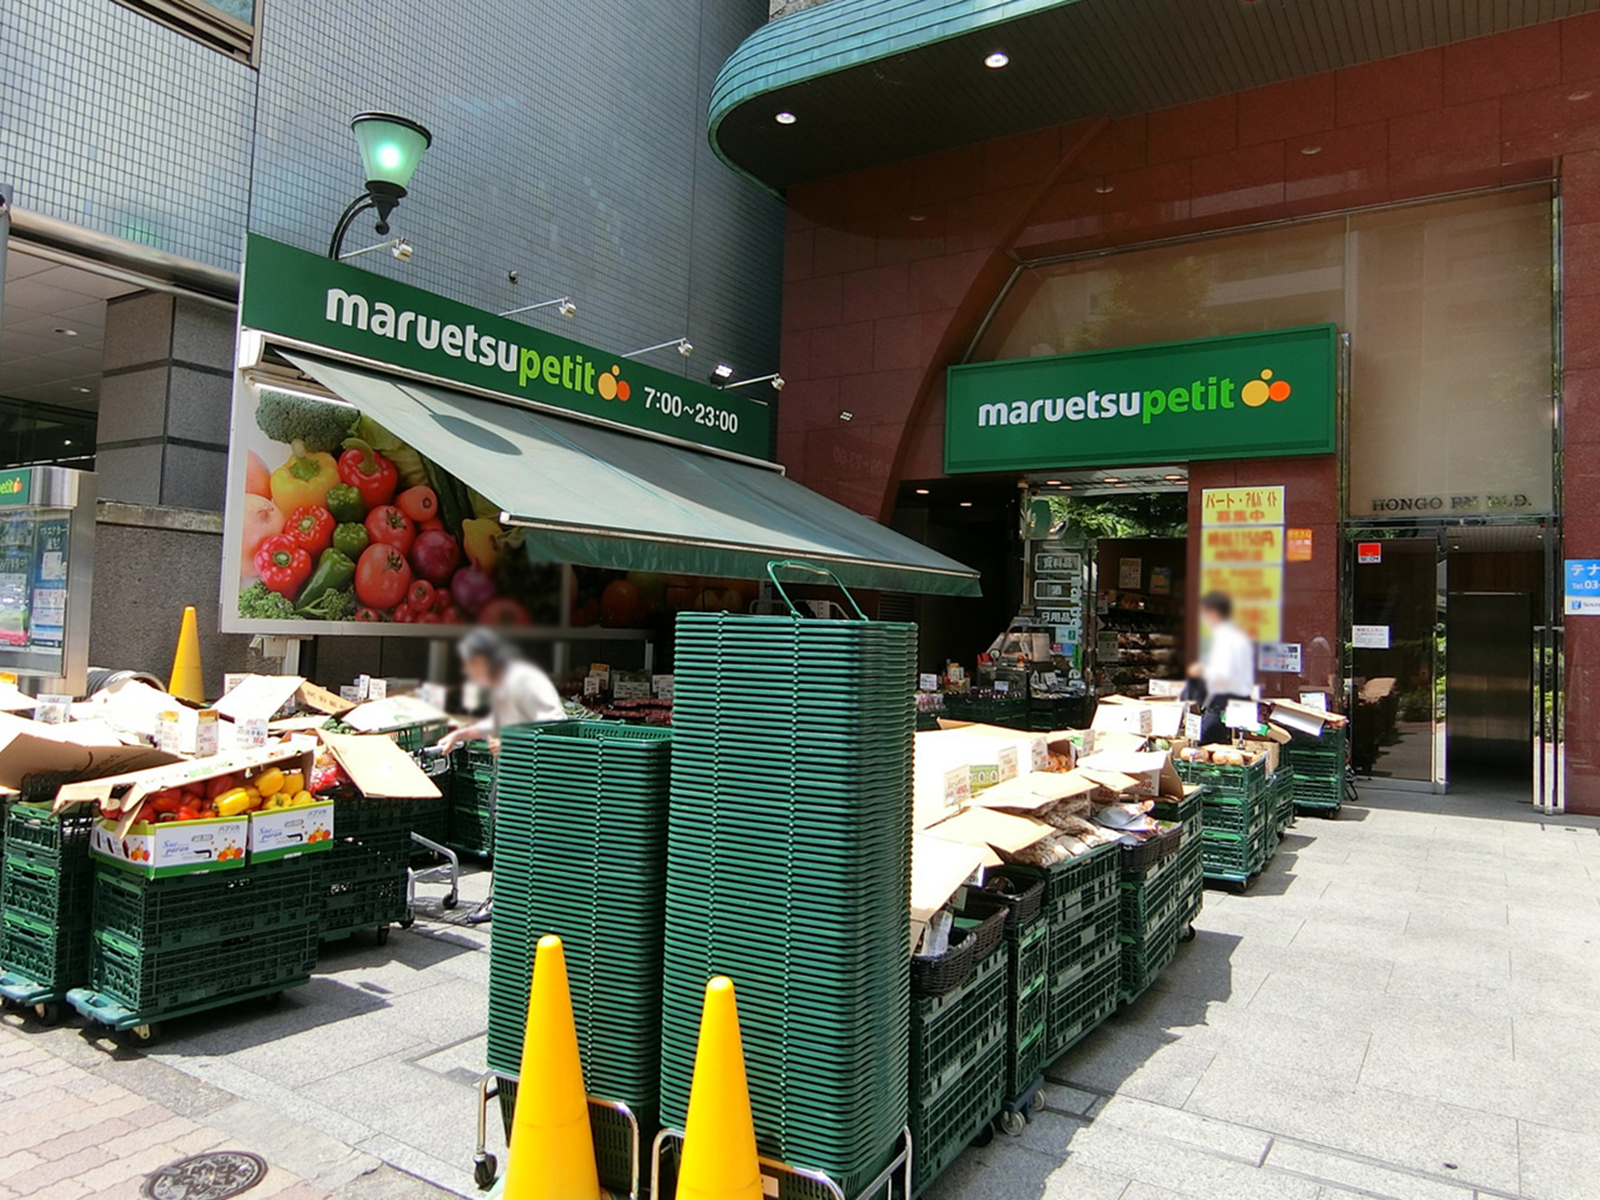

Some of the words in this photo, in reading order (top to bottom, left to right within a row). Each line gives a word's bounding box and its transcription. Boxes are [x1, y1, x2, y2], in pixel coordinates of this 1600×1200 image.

[1372, 496, 1443, 511] HONGO
[1041, 611, 1071, 622] 日用品
